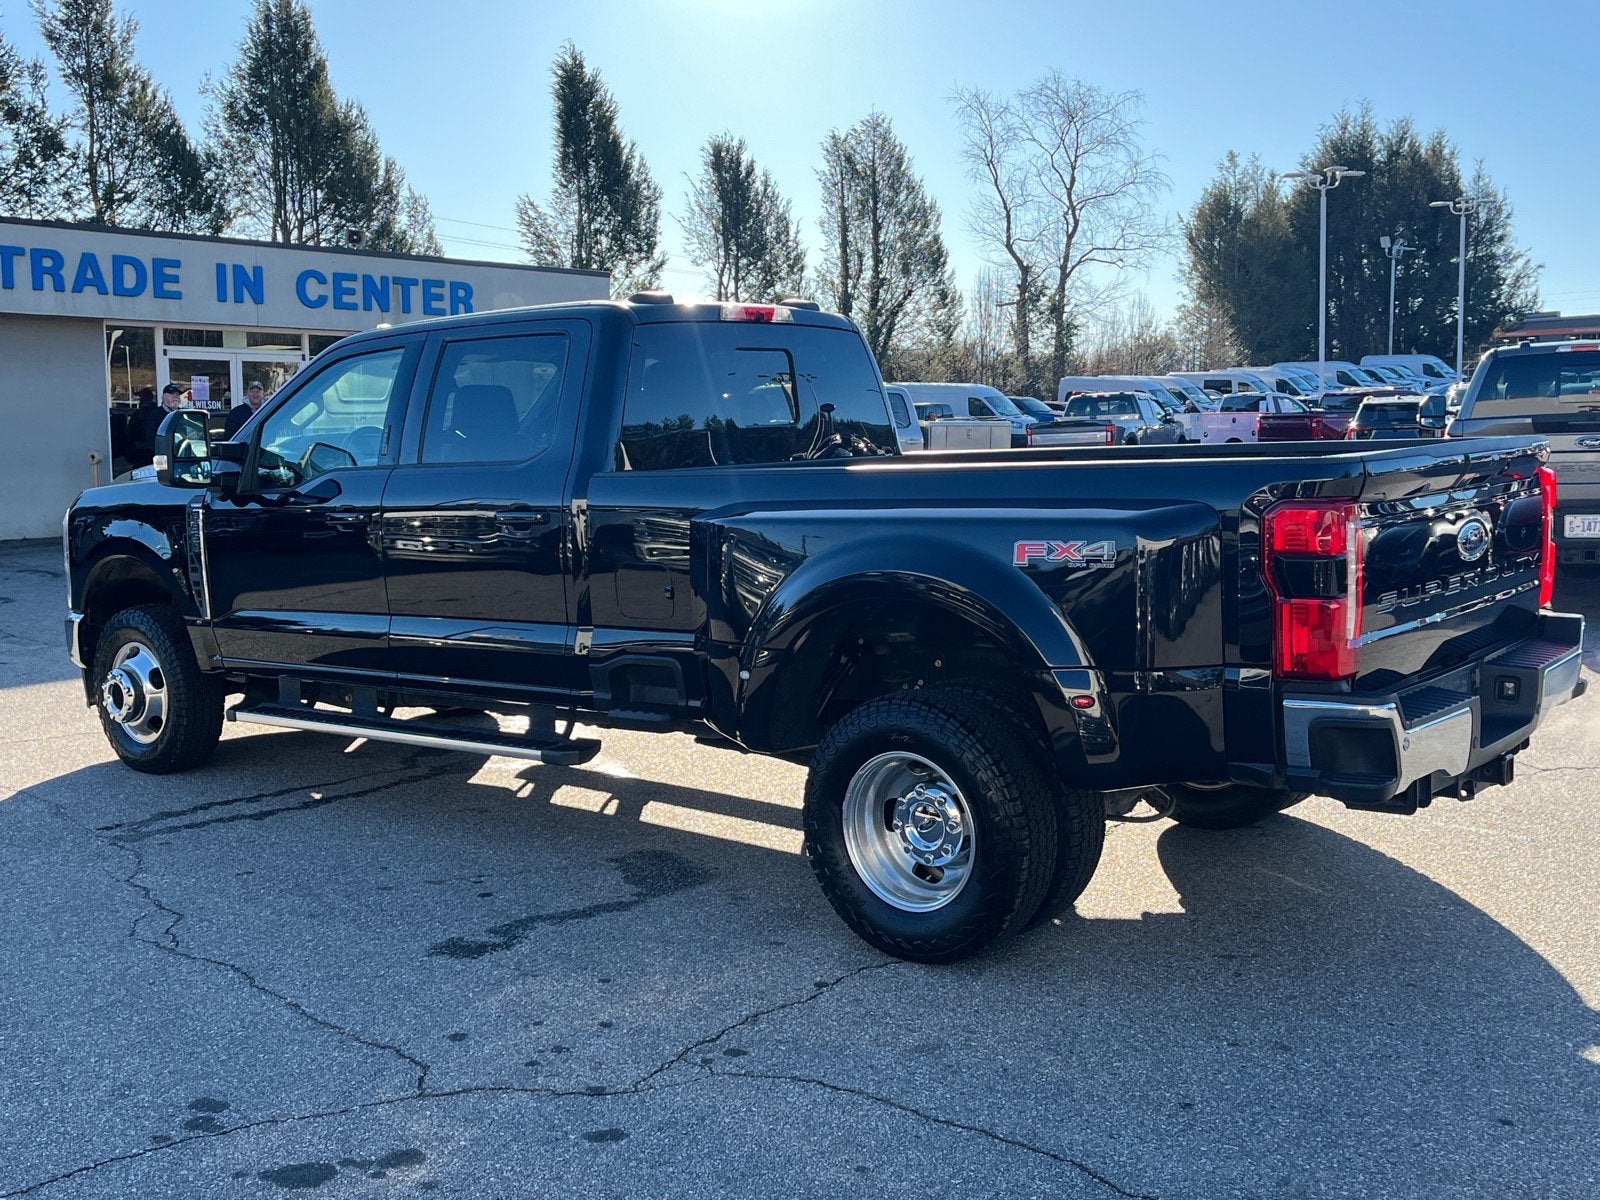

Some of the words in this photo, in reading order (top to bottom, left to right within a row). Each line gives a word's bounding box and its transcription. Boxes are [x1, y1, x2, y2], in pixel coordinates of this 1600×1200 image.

[0, 245, 182, 299] TRADE
[215, 262, 264, 304] IN
[296, 269, 474, 316] CENTER
[195, 401, 221, 410] WILSON
[1013, 540, 1116, 566] FX4
[1376, 567, 1481, 614] SUPER
[1486, 552, 1540, 583] DUTY
